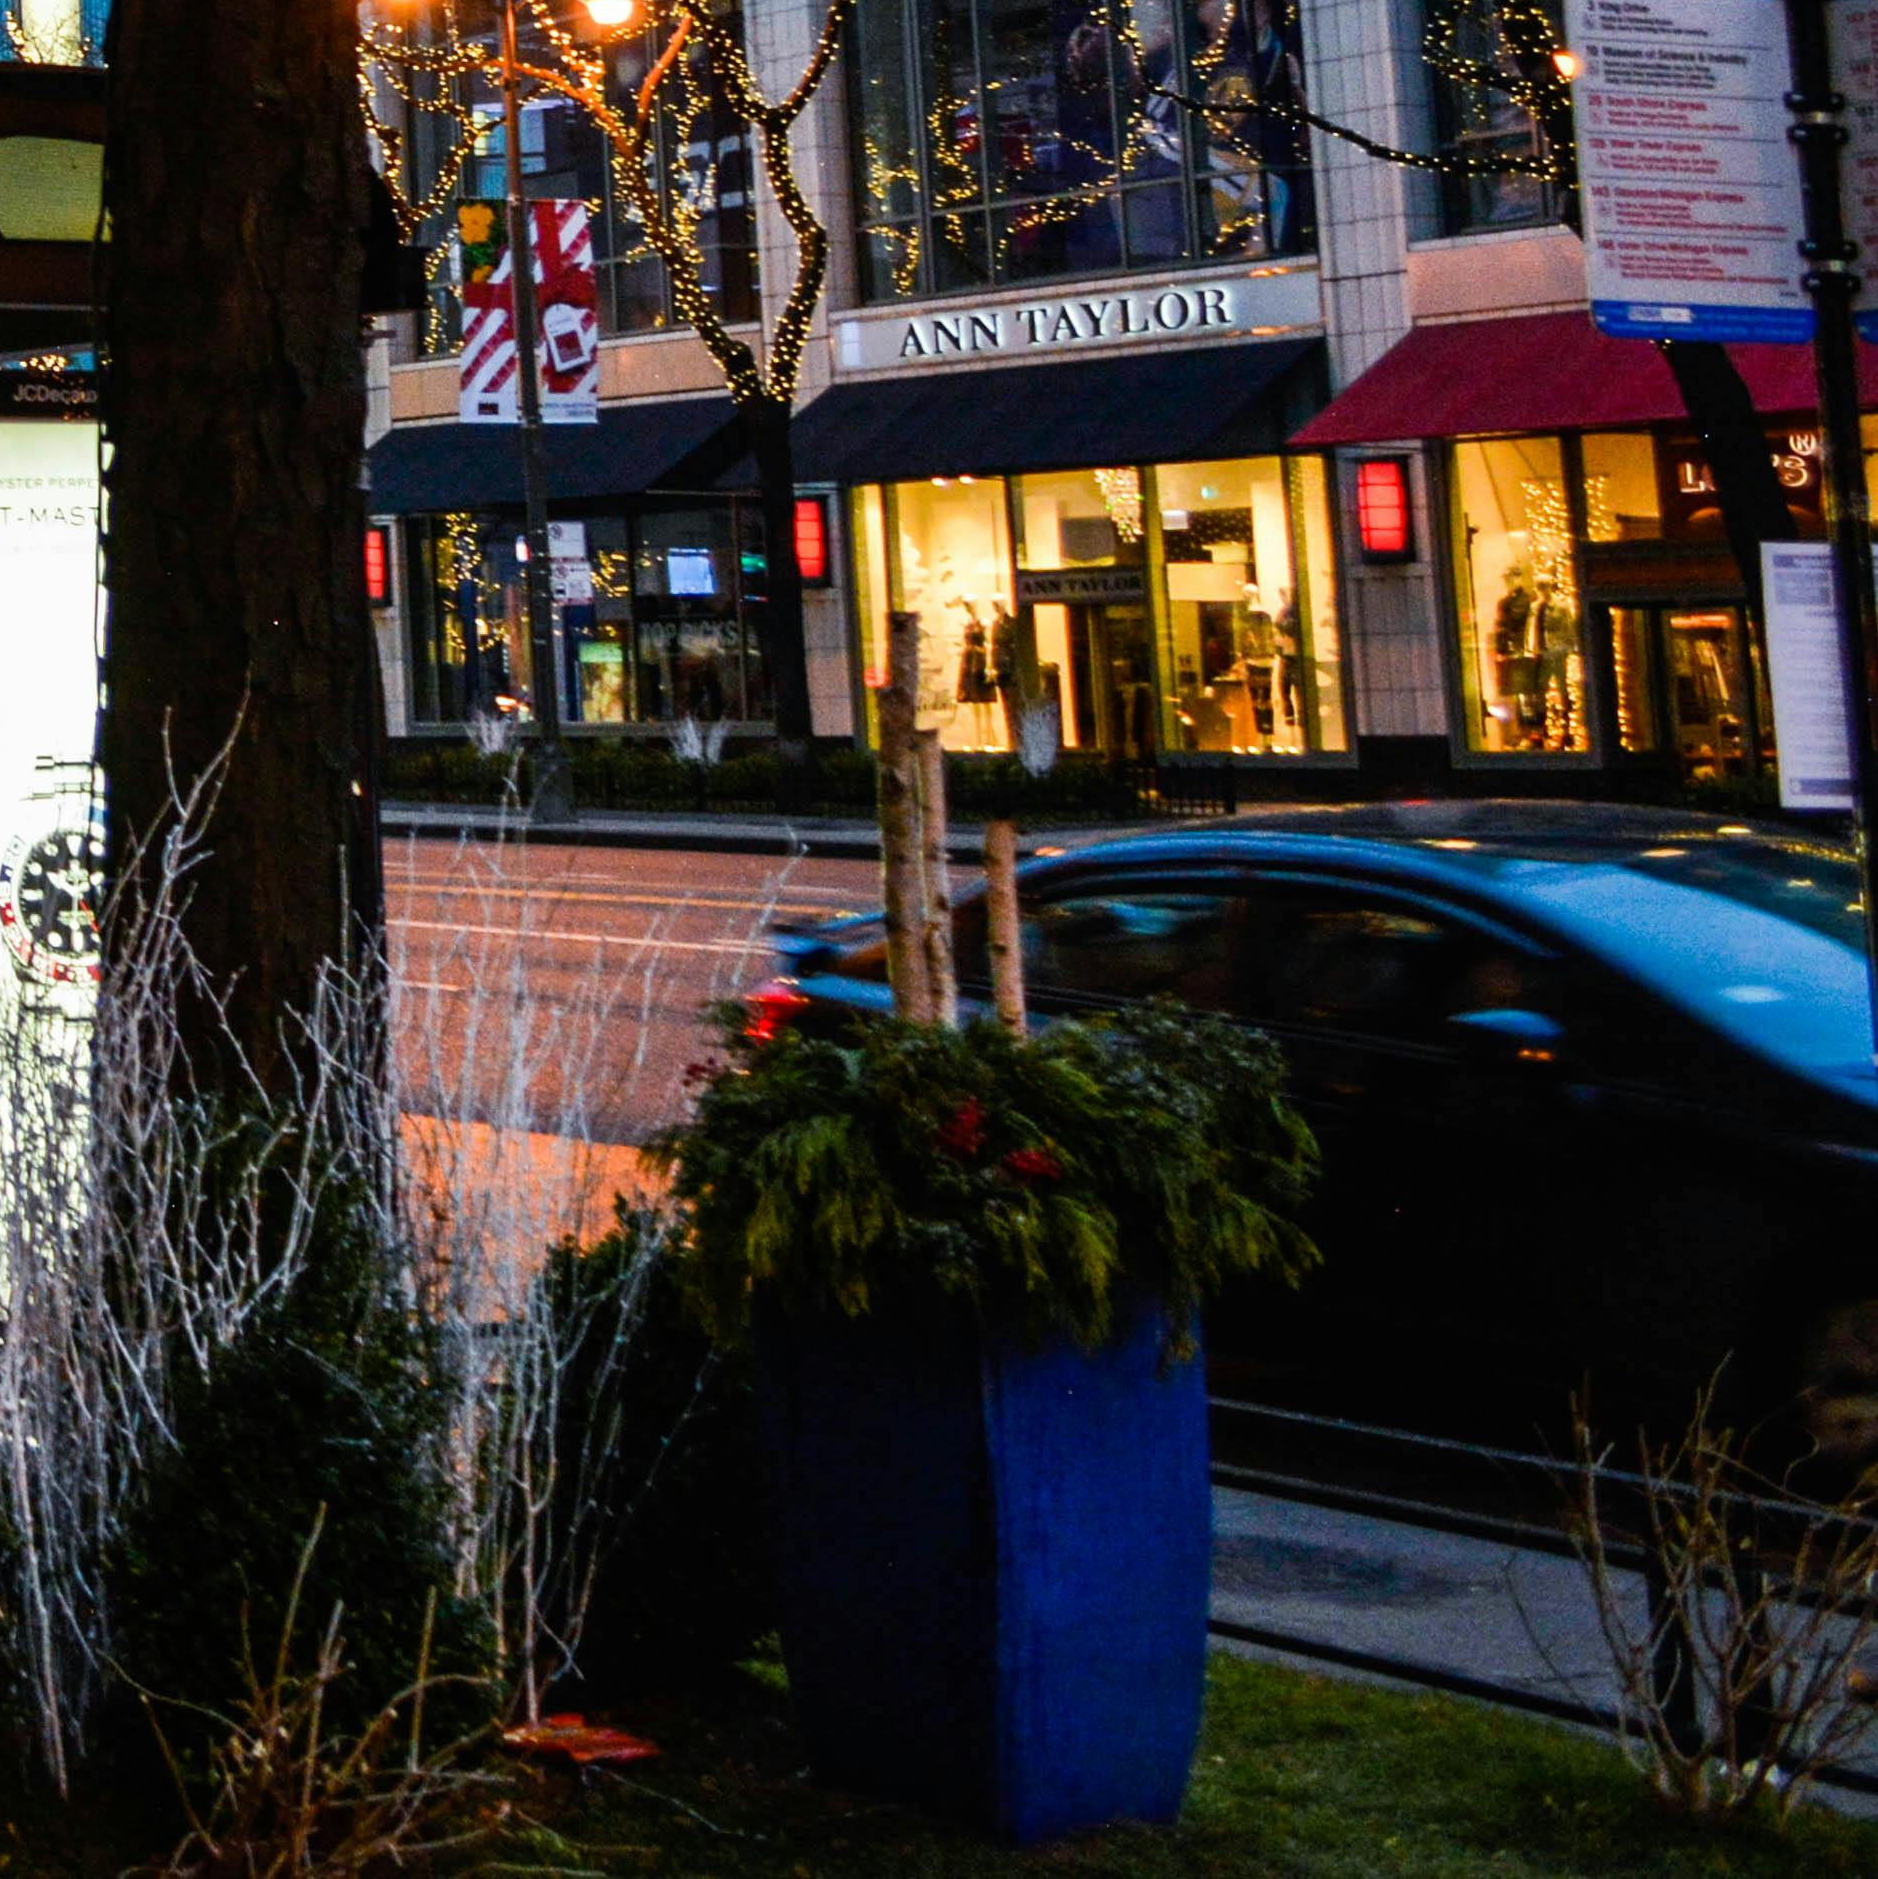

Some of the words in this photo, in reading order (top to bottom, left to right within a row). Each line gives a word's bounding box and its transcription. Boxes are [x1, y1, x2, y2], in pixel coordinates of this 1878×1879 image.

[1602, 46, 1642, 57] Museum
[1658, 49, 1695, 61] Science
[1707, 52, 1747, 66] Industry
[1607, 96, 1634, 107] South
[1668, 99, 1708, 112] Express
[1666, 141, 1703, 152] Express
[1704, 190, 1745, 203] Express
[1712, 245, 1749, 256] Express
[899, 313, 1001, 358] ANN
[1016, 288, 1232, 345] TAYLOR
[48, 478, 99, 489] PERPE
[1024, 578, 1062, 595] ANN
[1068, 574, 1142, 593] TAYLOR
